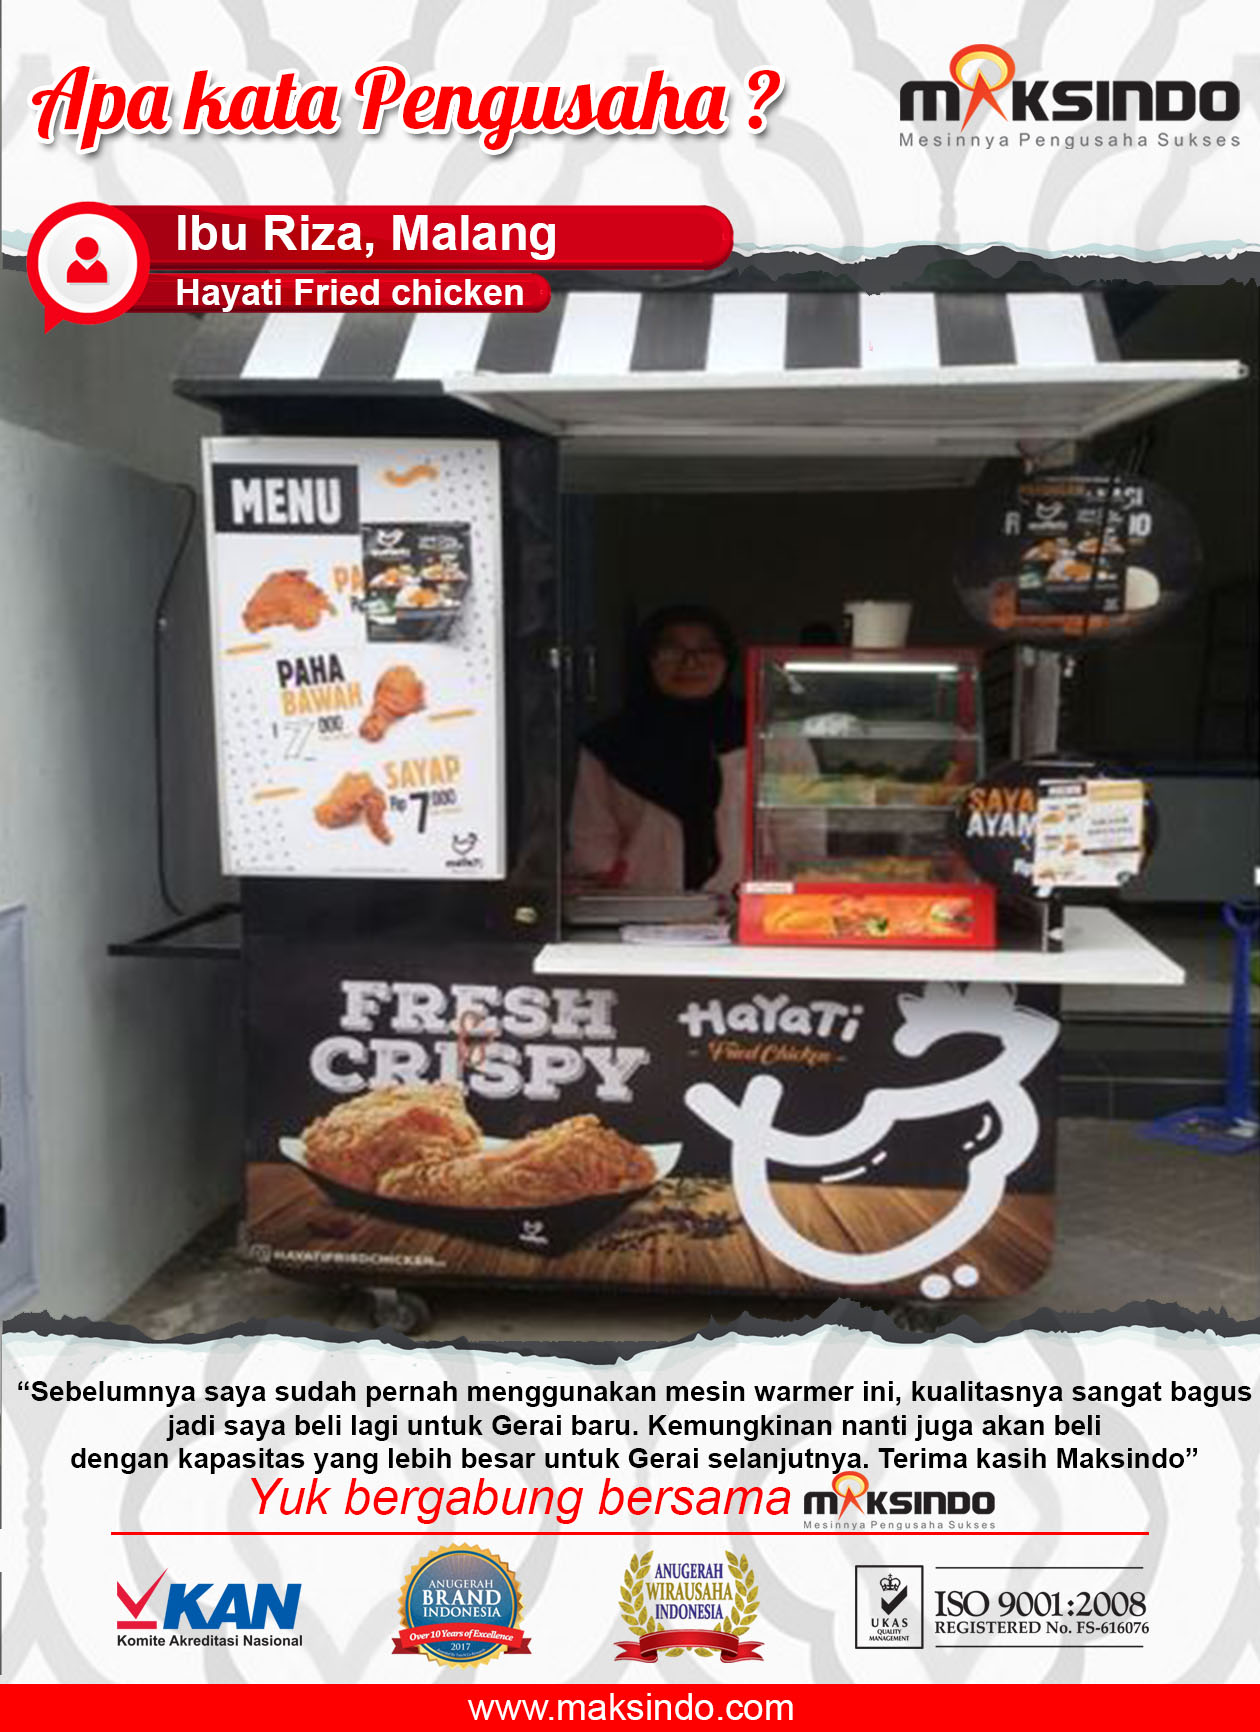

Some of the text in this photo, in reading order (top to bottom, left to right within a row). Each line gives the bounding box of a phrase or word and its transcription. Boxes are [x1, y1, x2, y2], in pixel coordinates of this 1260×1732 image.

[230, 477, 342, 525] MENU
[276, 653, 345, 688] PAHA
[282, 681, 363, 716] BAWAH
[385, 753, 461, 790] SAYAP
[340, 980, 618, 1039] FRESH
[310, 1036, 650, 1101] CRISPY
